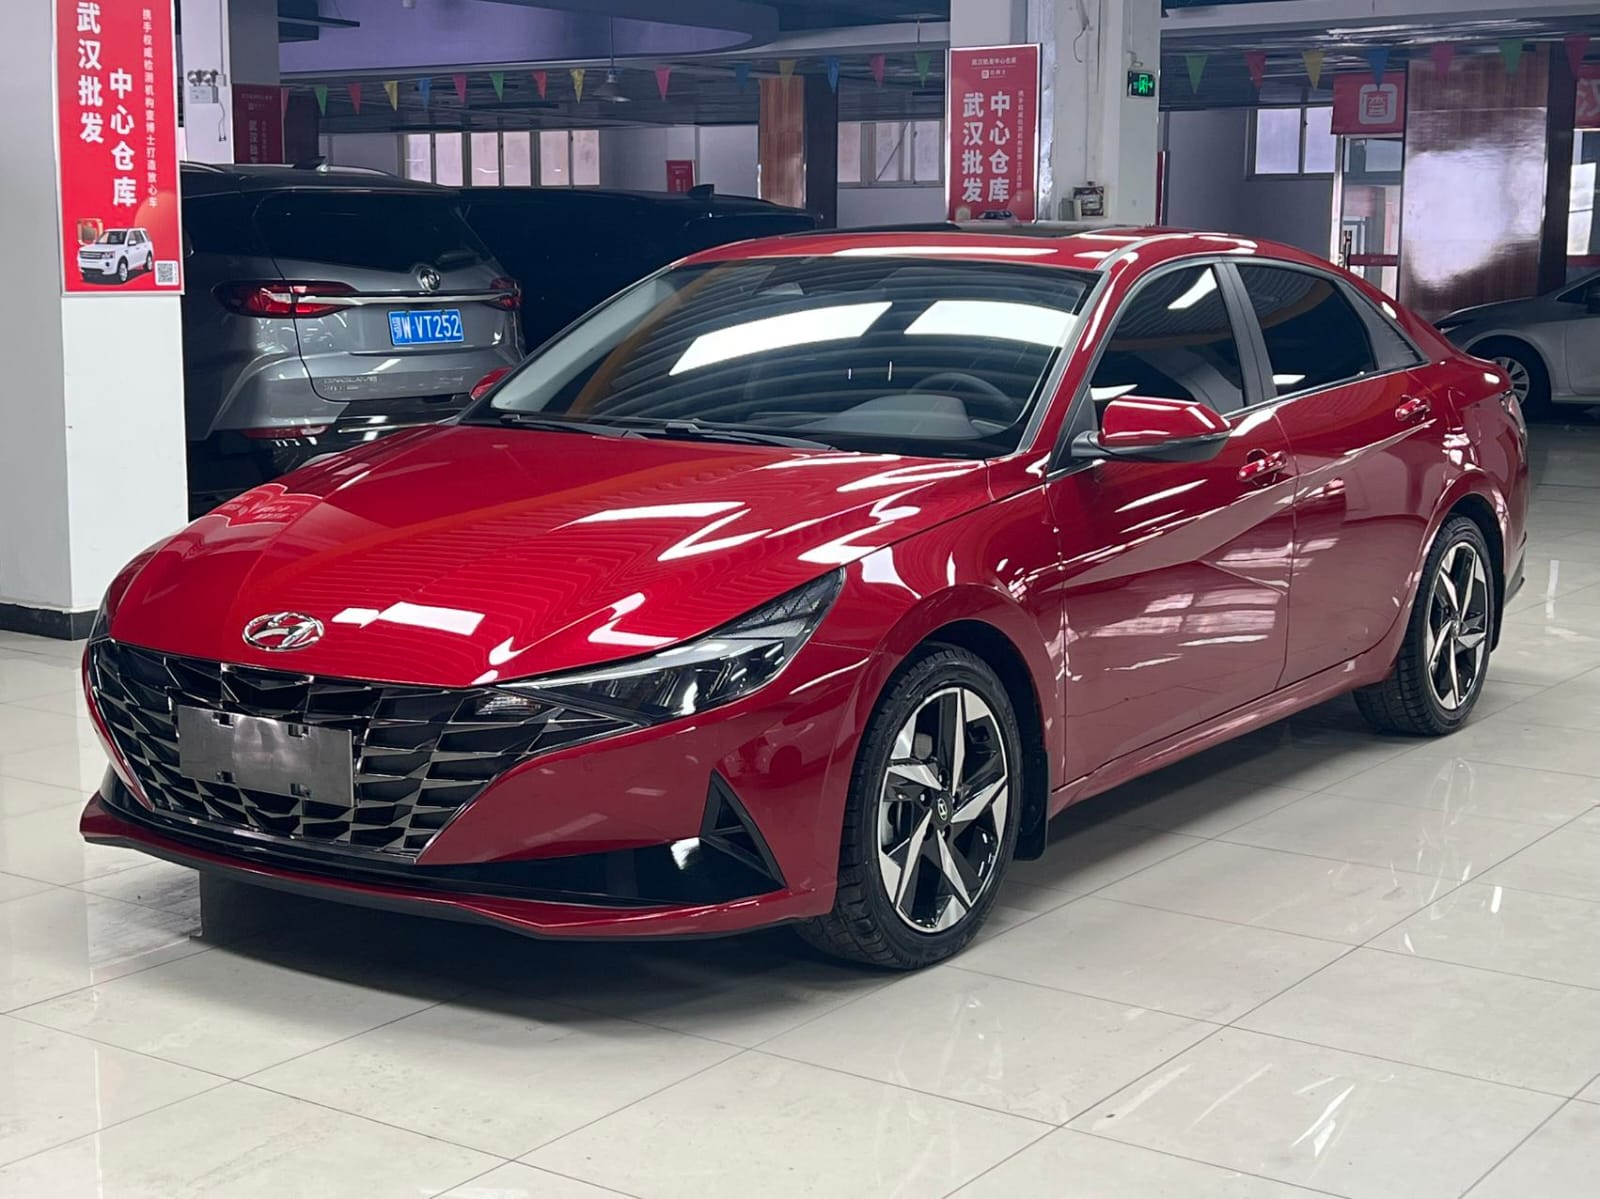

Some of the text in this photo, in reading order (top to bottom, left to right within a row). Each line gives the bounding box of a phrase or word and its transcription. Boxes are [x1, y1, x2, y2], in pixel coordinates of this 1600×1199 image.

[76, 2, 104, 144] 武汉批发
[110, 68, 137, 207] 中心仓库
[962, 92, 984, 203] 武汉批发
[988, 91, 1011, 203] 中心仓库
